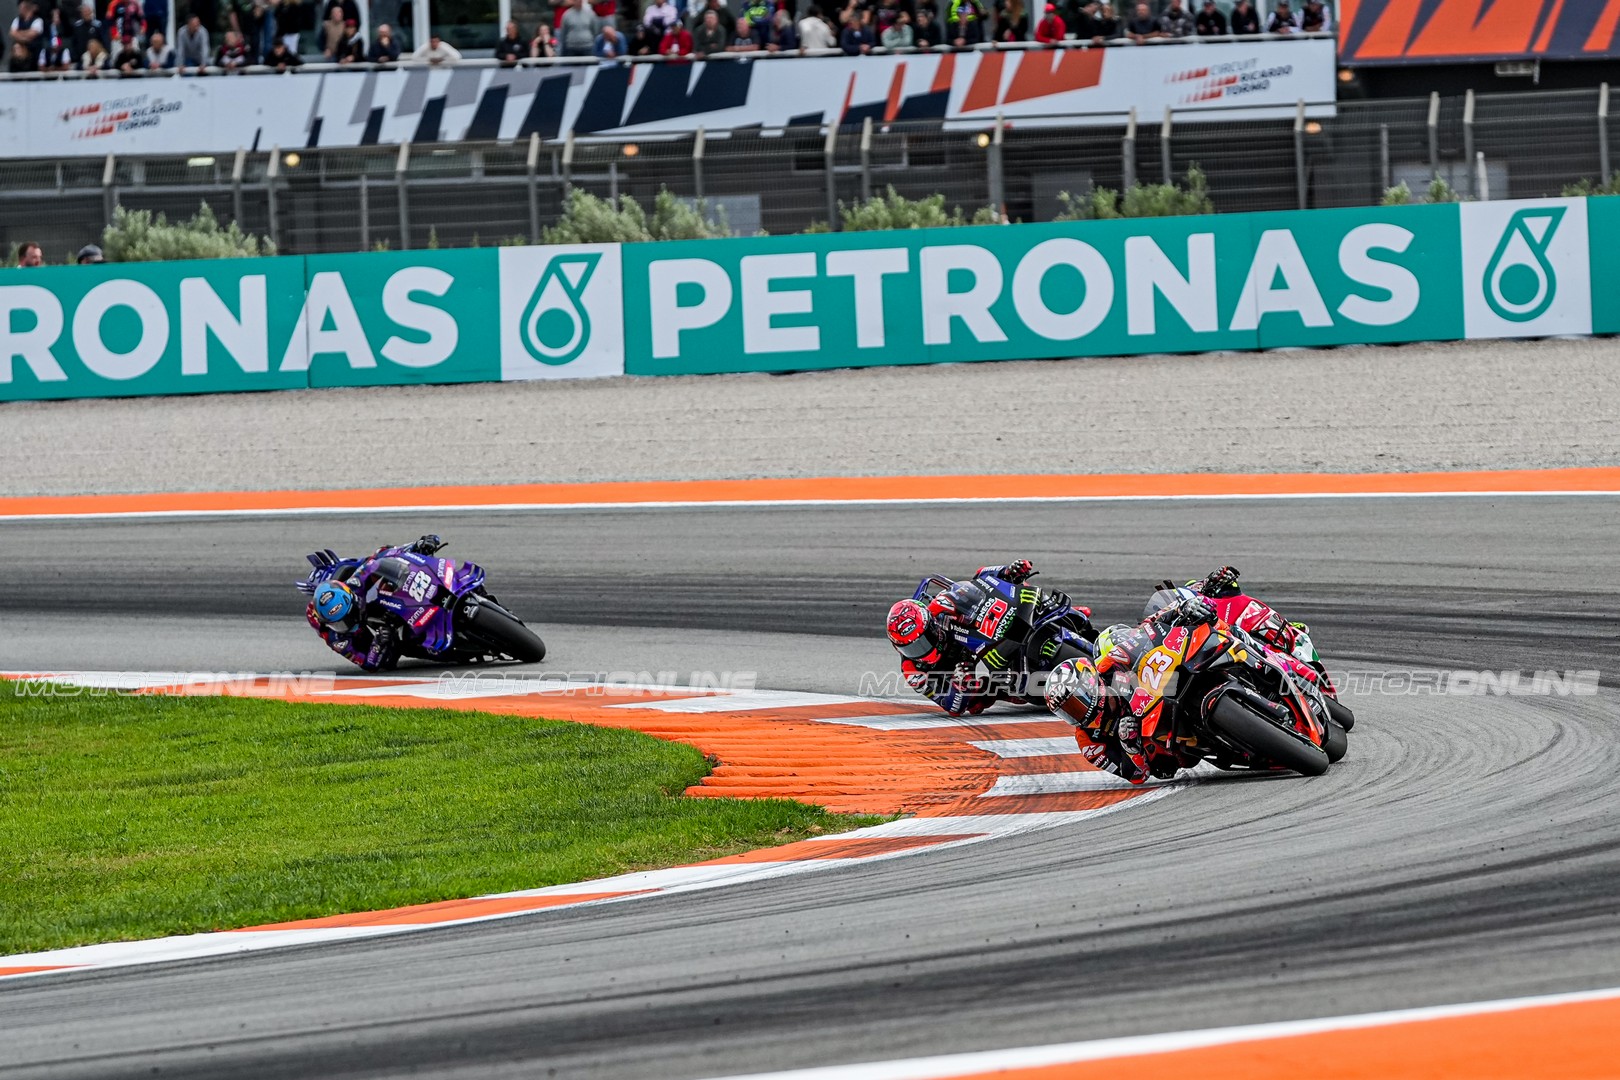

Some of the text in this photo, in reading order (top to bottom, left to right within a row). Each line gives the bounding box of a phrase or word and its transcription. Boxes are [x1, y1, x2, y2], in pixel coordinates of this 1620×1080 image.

[1210, 57, 1258, 75] CIRCUIT
[1240, 64, 1293, 82] RICARDO
[1226, 79, 1270, 95] TORMO
[131, 100, 182, 118] RICARDO
[116, 115, 160, 131] TORMO
[648, 222, 1420, 358] PETRONAS
[0, 266, 459, 383] RONAS
[409, 570, 432, 603] 88
[407, 606, 425, 626] prima
[977, 597, 995, 622] ENEOS
[977, 597, 1008, 639] 20
[993, 606, 1017, 641] MONSTER
[1142, 650, 1174, 690] 23
